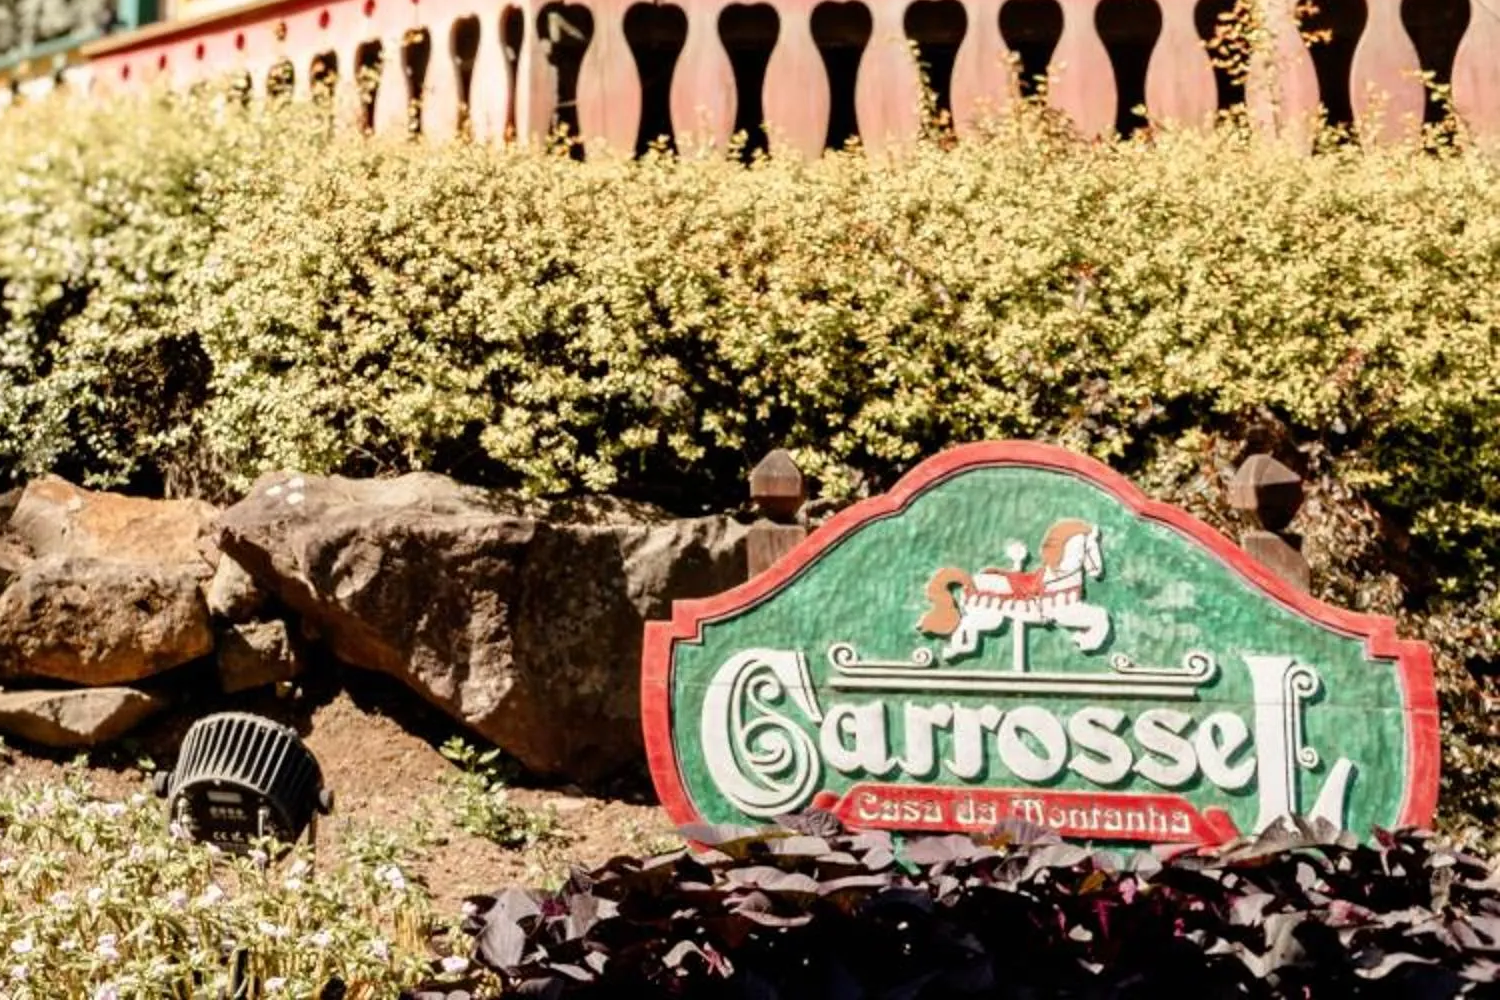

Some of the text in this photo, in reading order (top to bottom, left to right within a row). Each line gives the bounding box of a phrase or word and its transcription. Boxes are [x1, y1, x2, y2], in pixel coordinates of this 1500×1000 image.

[859, 792, 1191, 834] Casa da Montanha
